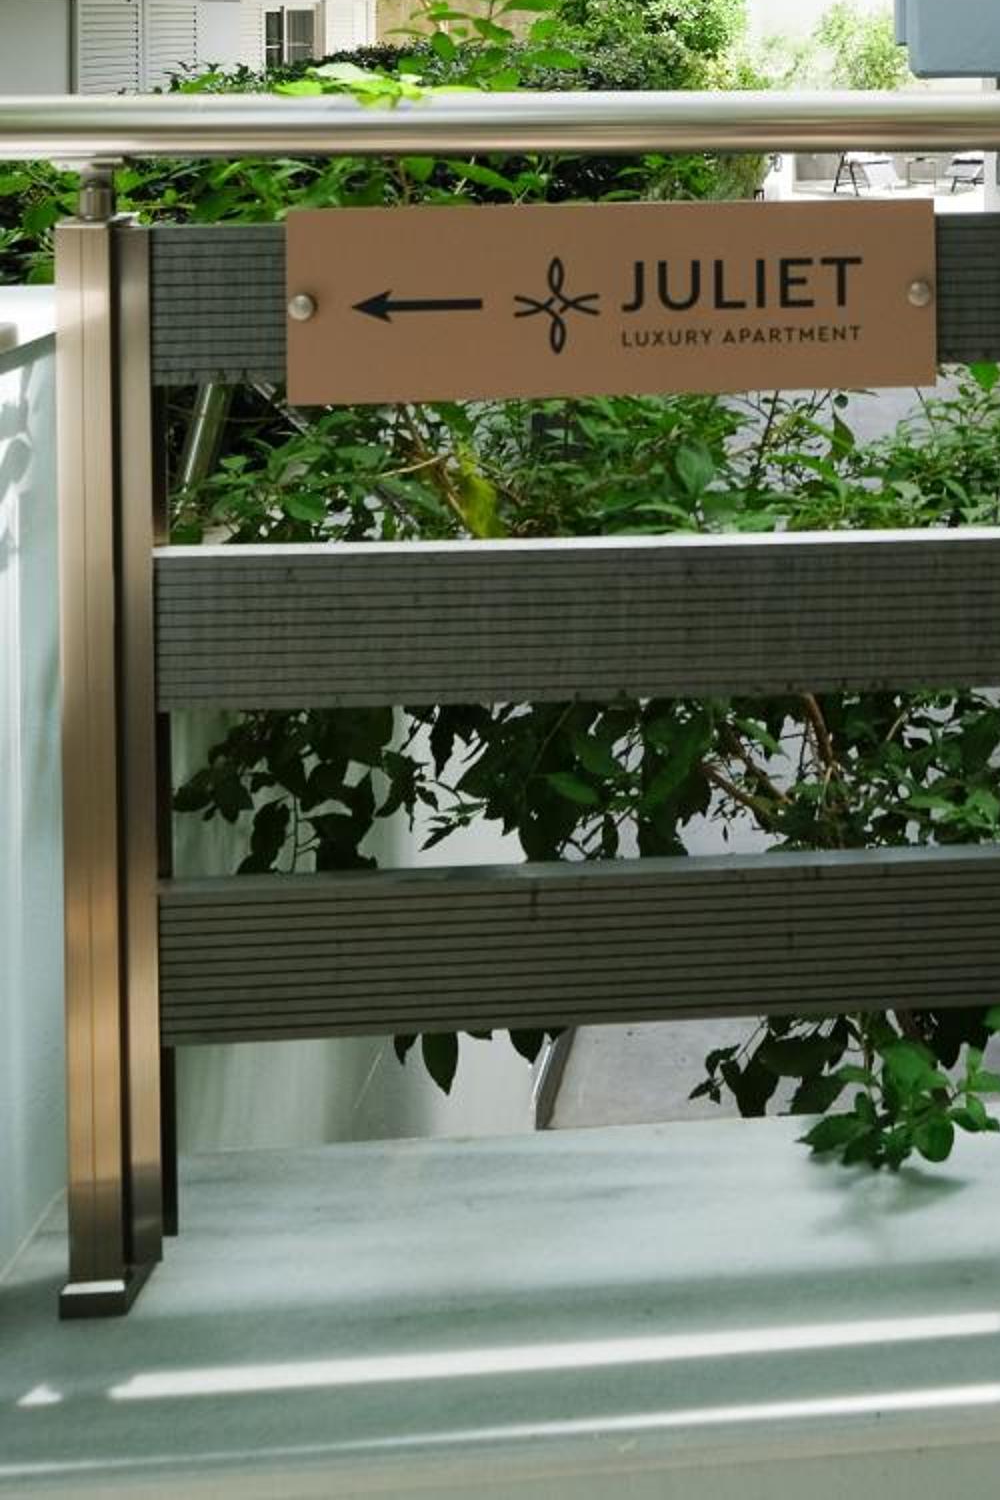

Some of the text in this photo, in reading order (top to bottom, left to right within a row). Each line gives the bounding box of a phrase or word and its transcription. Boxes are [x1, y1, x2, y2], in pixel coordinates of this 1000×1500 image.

[620, 256, 863, 312] JULIET
[621, 325, 862, 348] LUXURY APARTMENT
